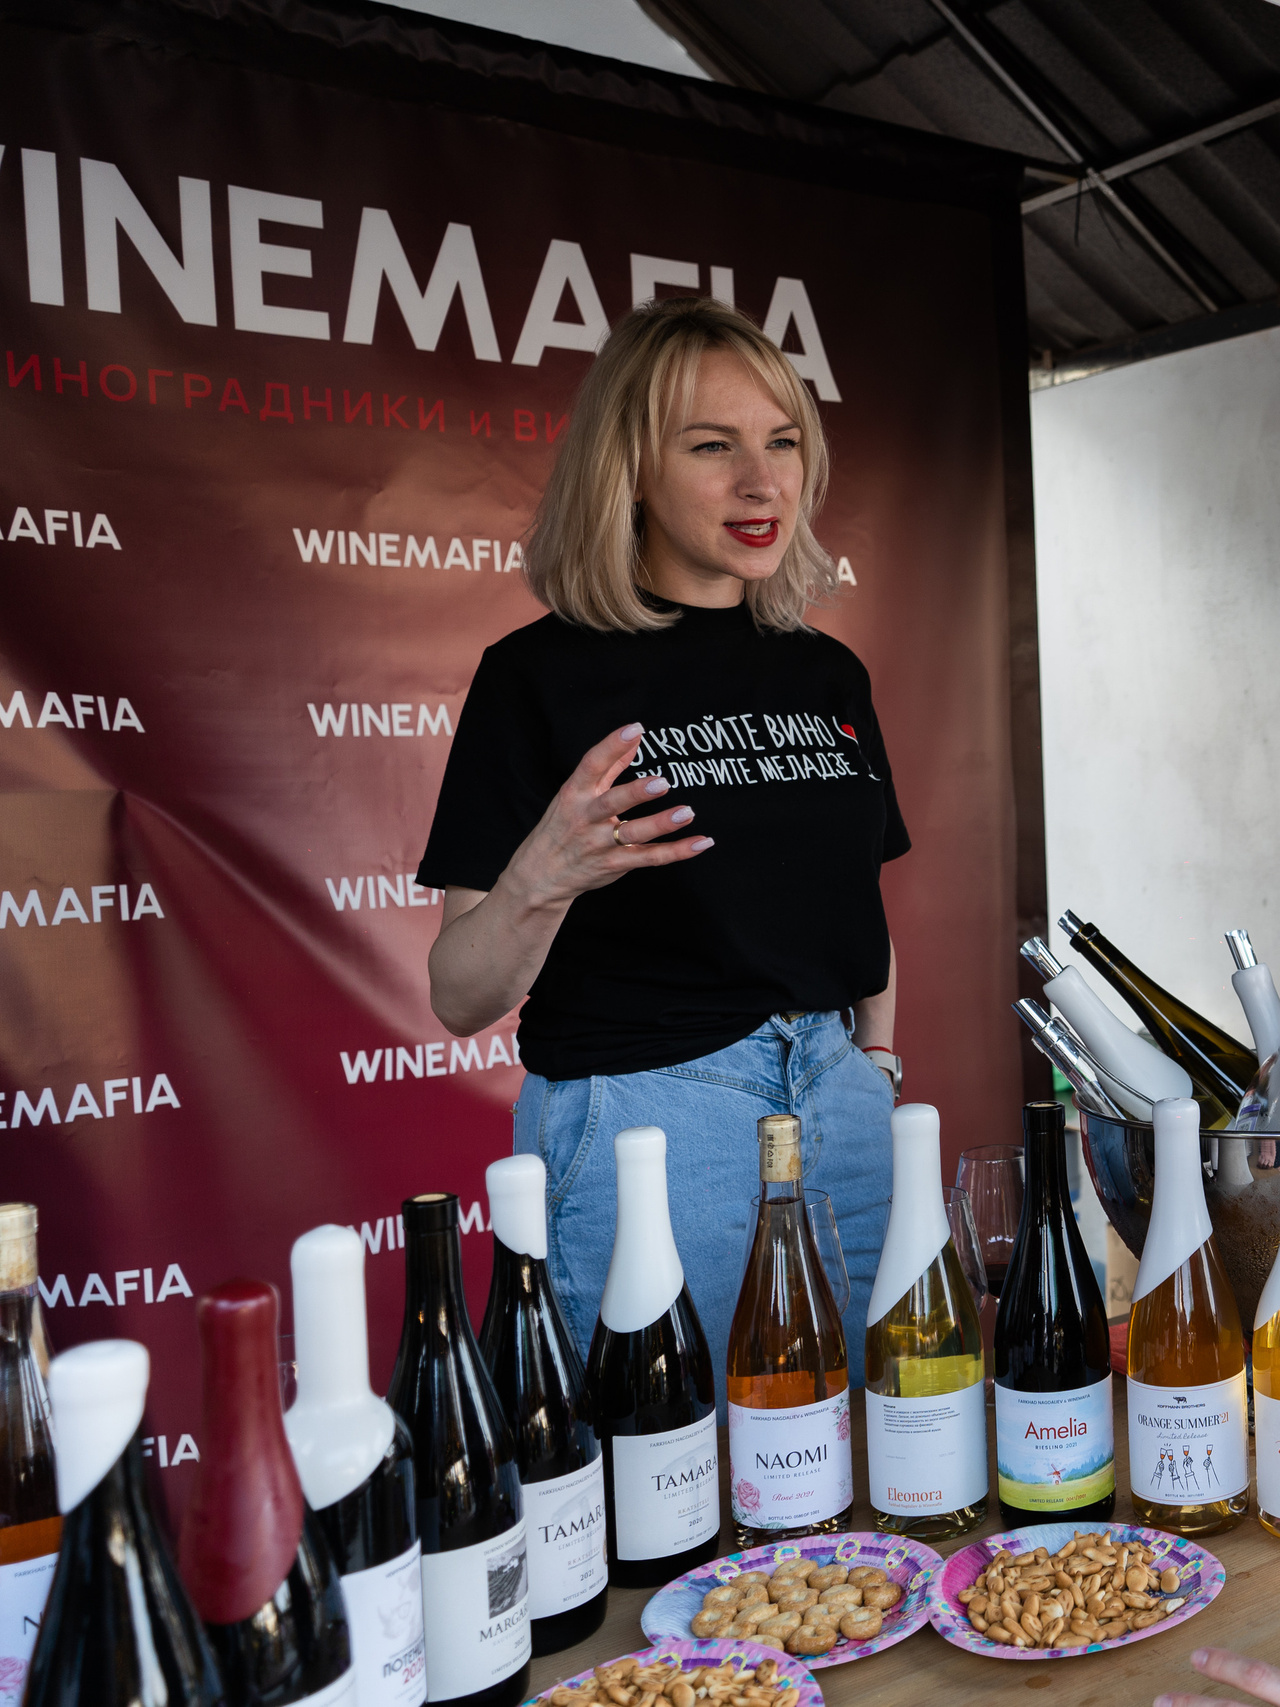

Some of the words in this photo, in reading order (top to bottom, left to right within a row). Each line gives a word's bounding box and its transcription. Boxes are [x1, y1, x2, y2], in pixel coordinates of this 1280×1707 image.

[513, 408, 567, 443] ВИ
[0, 506, 122, 550] AFIA
[763, 712, 836, 748] ВИНО
[756, 752, 858, 782] МЕЛАДЗЕ
[1024, 1417, 1087, 1440] Amelia
[1138, 1413, 1172, 1429] ORANGE
[756, 1444, 828, 1470] NAOMI
[651, 1454, 718, 1491] TAMARA
[793, 1468, 821, 1478] RELEASE
[663, 1485, 694, 1500] LIMITED
[887, 1487, 943, 1502] Eleonora
